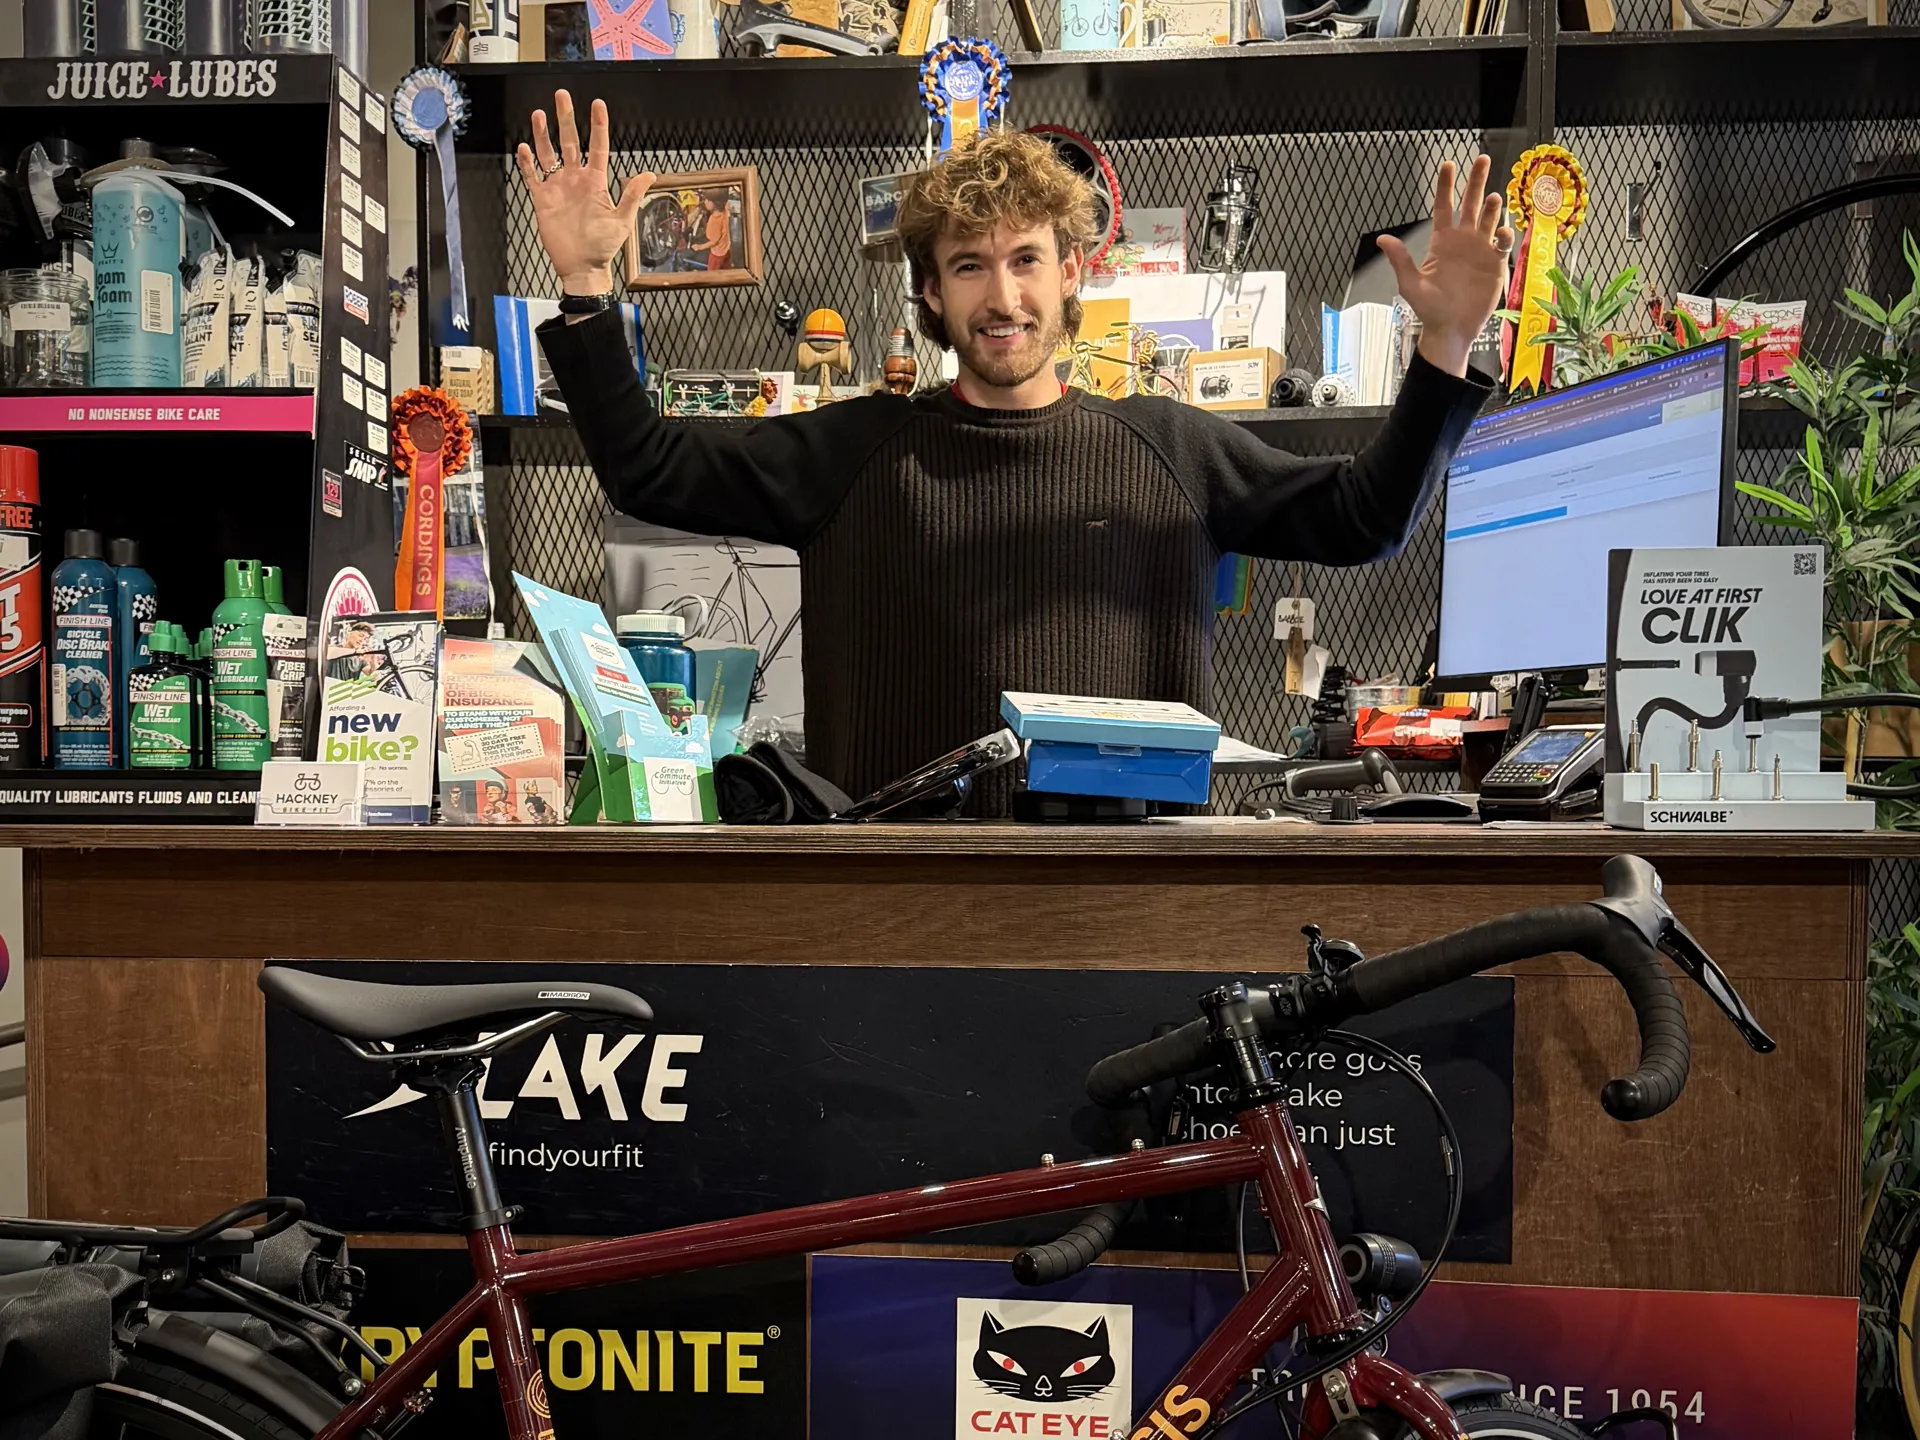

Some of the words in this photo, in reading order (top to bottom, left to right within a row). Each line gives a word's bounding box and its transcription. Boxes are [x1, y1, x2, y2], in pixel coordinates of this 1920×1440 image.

[47, 61, 149, 99] JUICE
[167, 59, 277, 98] LUBES
[866, 190, 902, 207] BARC
[97, 285, 132, 311] foam
[68, 408, 84, 420] NO
[89, 408, 152, 420] NONSENSE
[157, 408, 183, 420] BIKE
[188, 408, 220, 420] CARE
[349, 447, 377, 465] SELLE
[344, 457, 377, 484] SMP
[416, 484, 435, 596] CORDINGS
[1640, 589, 1688, 605] LOVE
[1688, 589, 1714, 604] AT
[1715, 588, 1763, 604] FIRST
[60, 616, 87, 625] FINISH
[1641, 607, 1750, 645] CLIK
[66, 630, 102, 639] BICYCLE
[56, 638, 79, 650] DISC
[65, 650, 103, 659] CLEANER
[232, 648, 252, 656] LINE
[217, 661, 242, 676] WET
[277, 660, 306, 671] FIBER
[280, 671, 305, 681] GRIP
[133, 693, 161, 701] FINISH
[446, 697, 533, 706] INSURANCE
[144, 704, 173, 718] WET
[329, 704, 359, 712] Affording
[328, 713, 402, 734] new
[445, 722, 483, 730] AGAINST
[326, 735, 419, 762] bike?
[482, 743, 505, 752] COVER
[654, 771, 692, 781] Commute
[660, 766, 684, 775] Green
[658, 779, 687, 787] Initiative
[56, 791, 133, 804] LUBRICANTS
[138, 791, 182, 804] FLUIDS
[187, 791, 212, 804] AND
[276, 794, 338, 804] HACKNEY
[1650, 811, 1727, 823] SCHWALBE
[475, 1032, 704, 1122] LAKE
[1288, 1083, 1343, 1107] ake
[1335, 1120, 1396, 1150] just
[455, 1127, 478, 1190] Amplitude
[971, 1410, 1110, 1438] CATEYE
